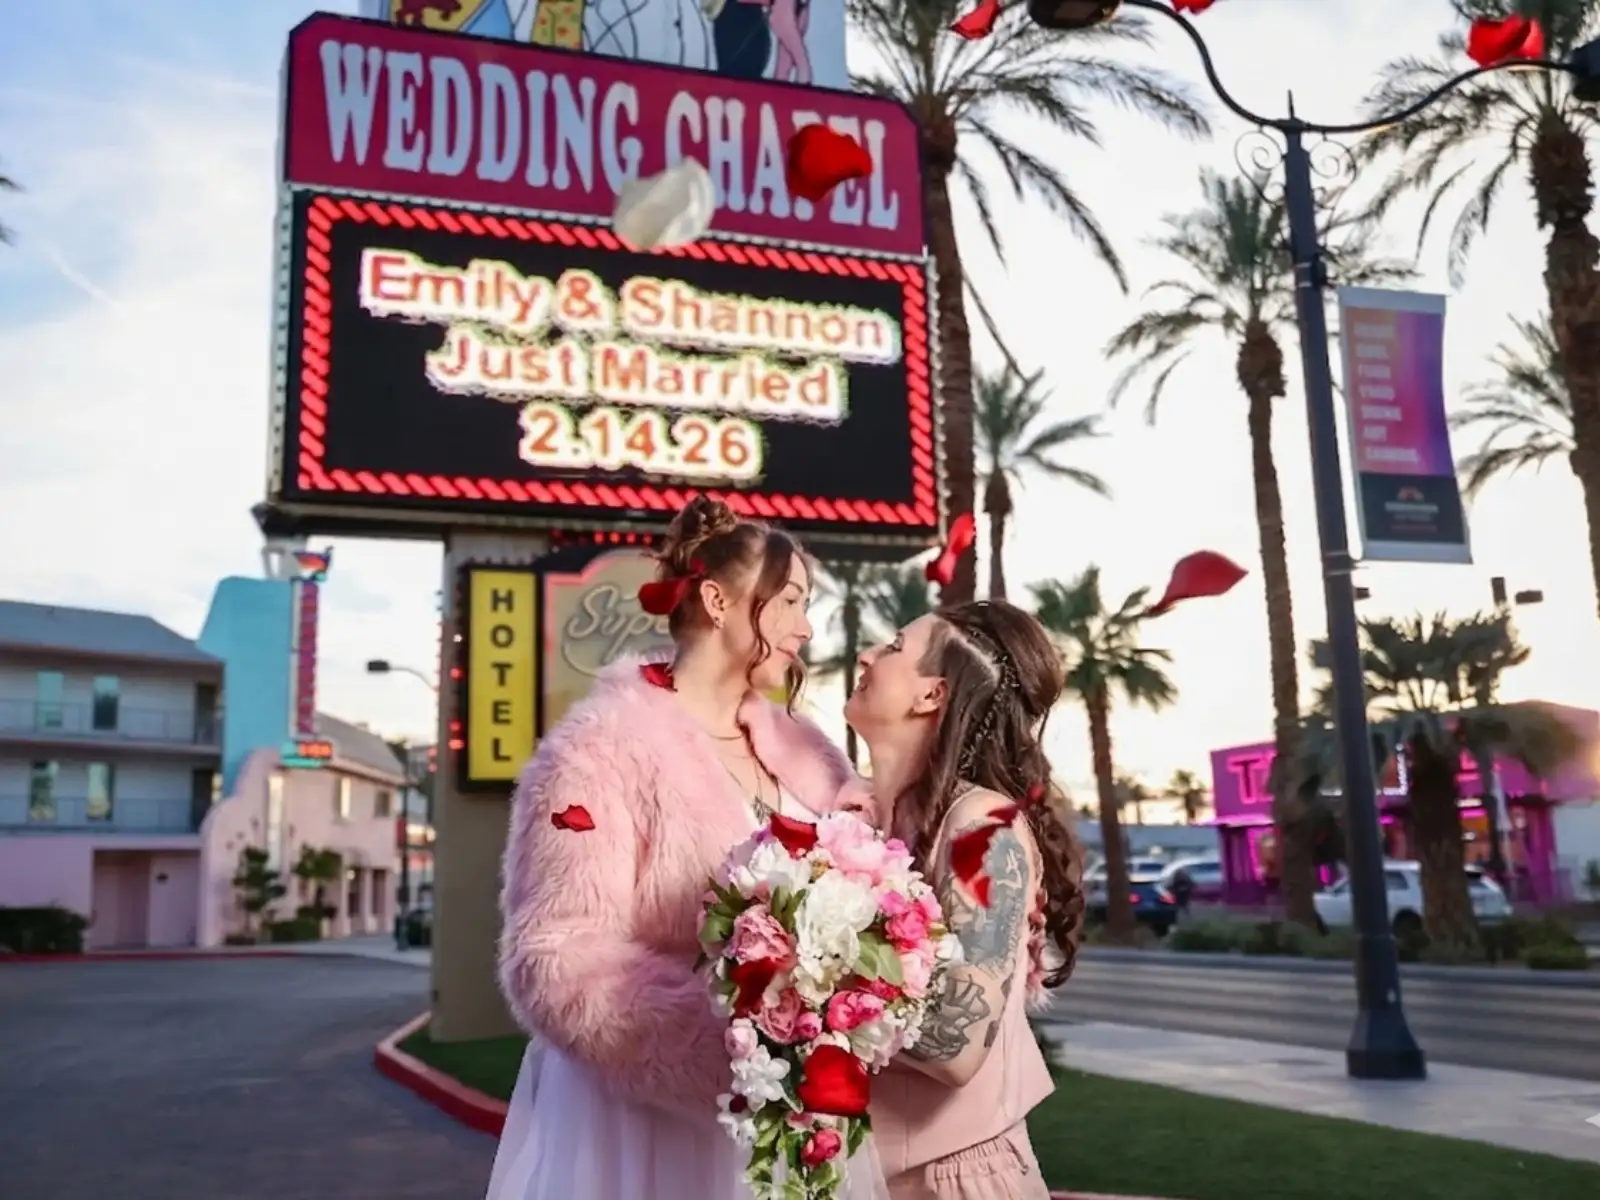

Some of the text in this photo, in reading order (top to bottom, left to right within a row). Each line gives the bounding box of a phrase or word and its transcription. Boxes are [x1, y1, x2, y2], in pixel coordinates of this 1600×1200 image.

[319, 38, 642, 193] WEDDING
[367, 253, 886, 350] Emily & Shannon
[437, 334, 832, 407] Just Married
[525, 407, 749, 467] 2.14.26
[490, 588, 515, 762] HOTEL
